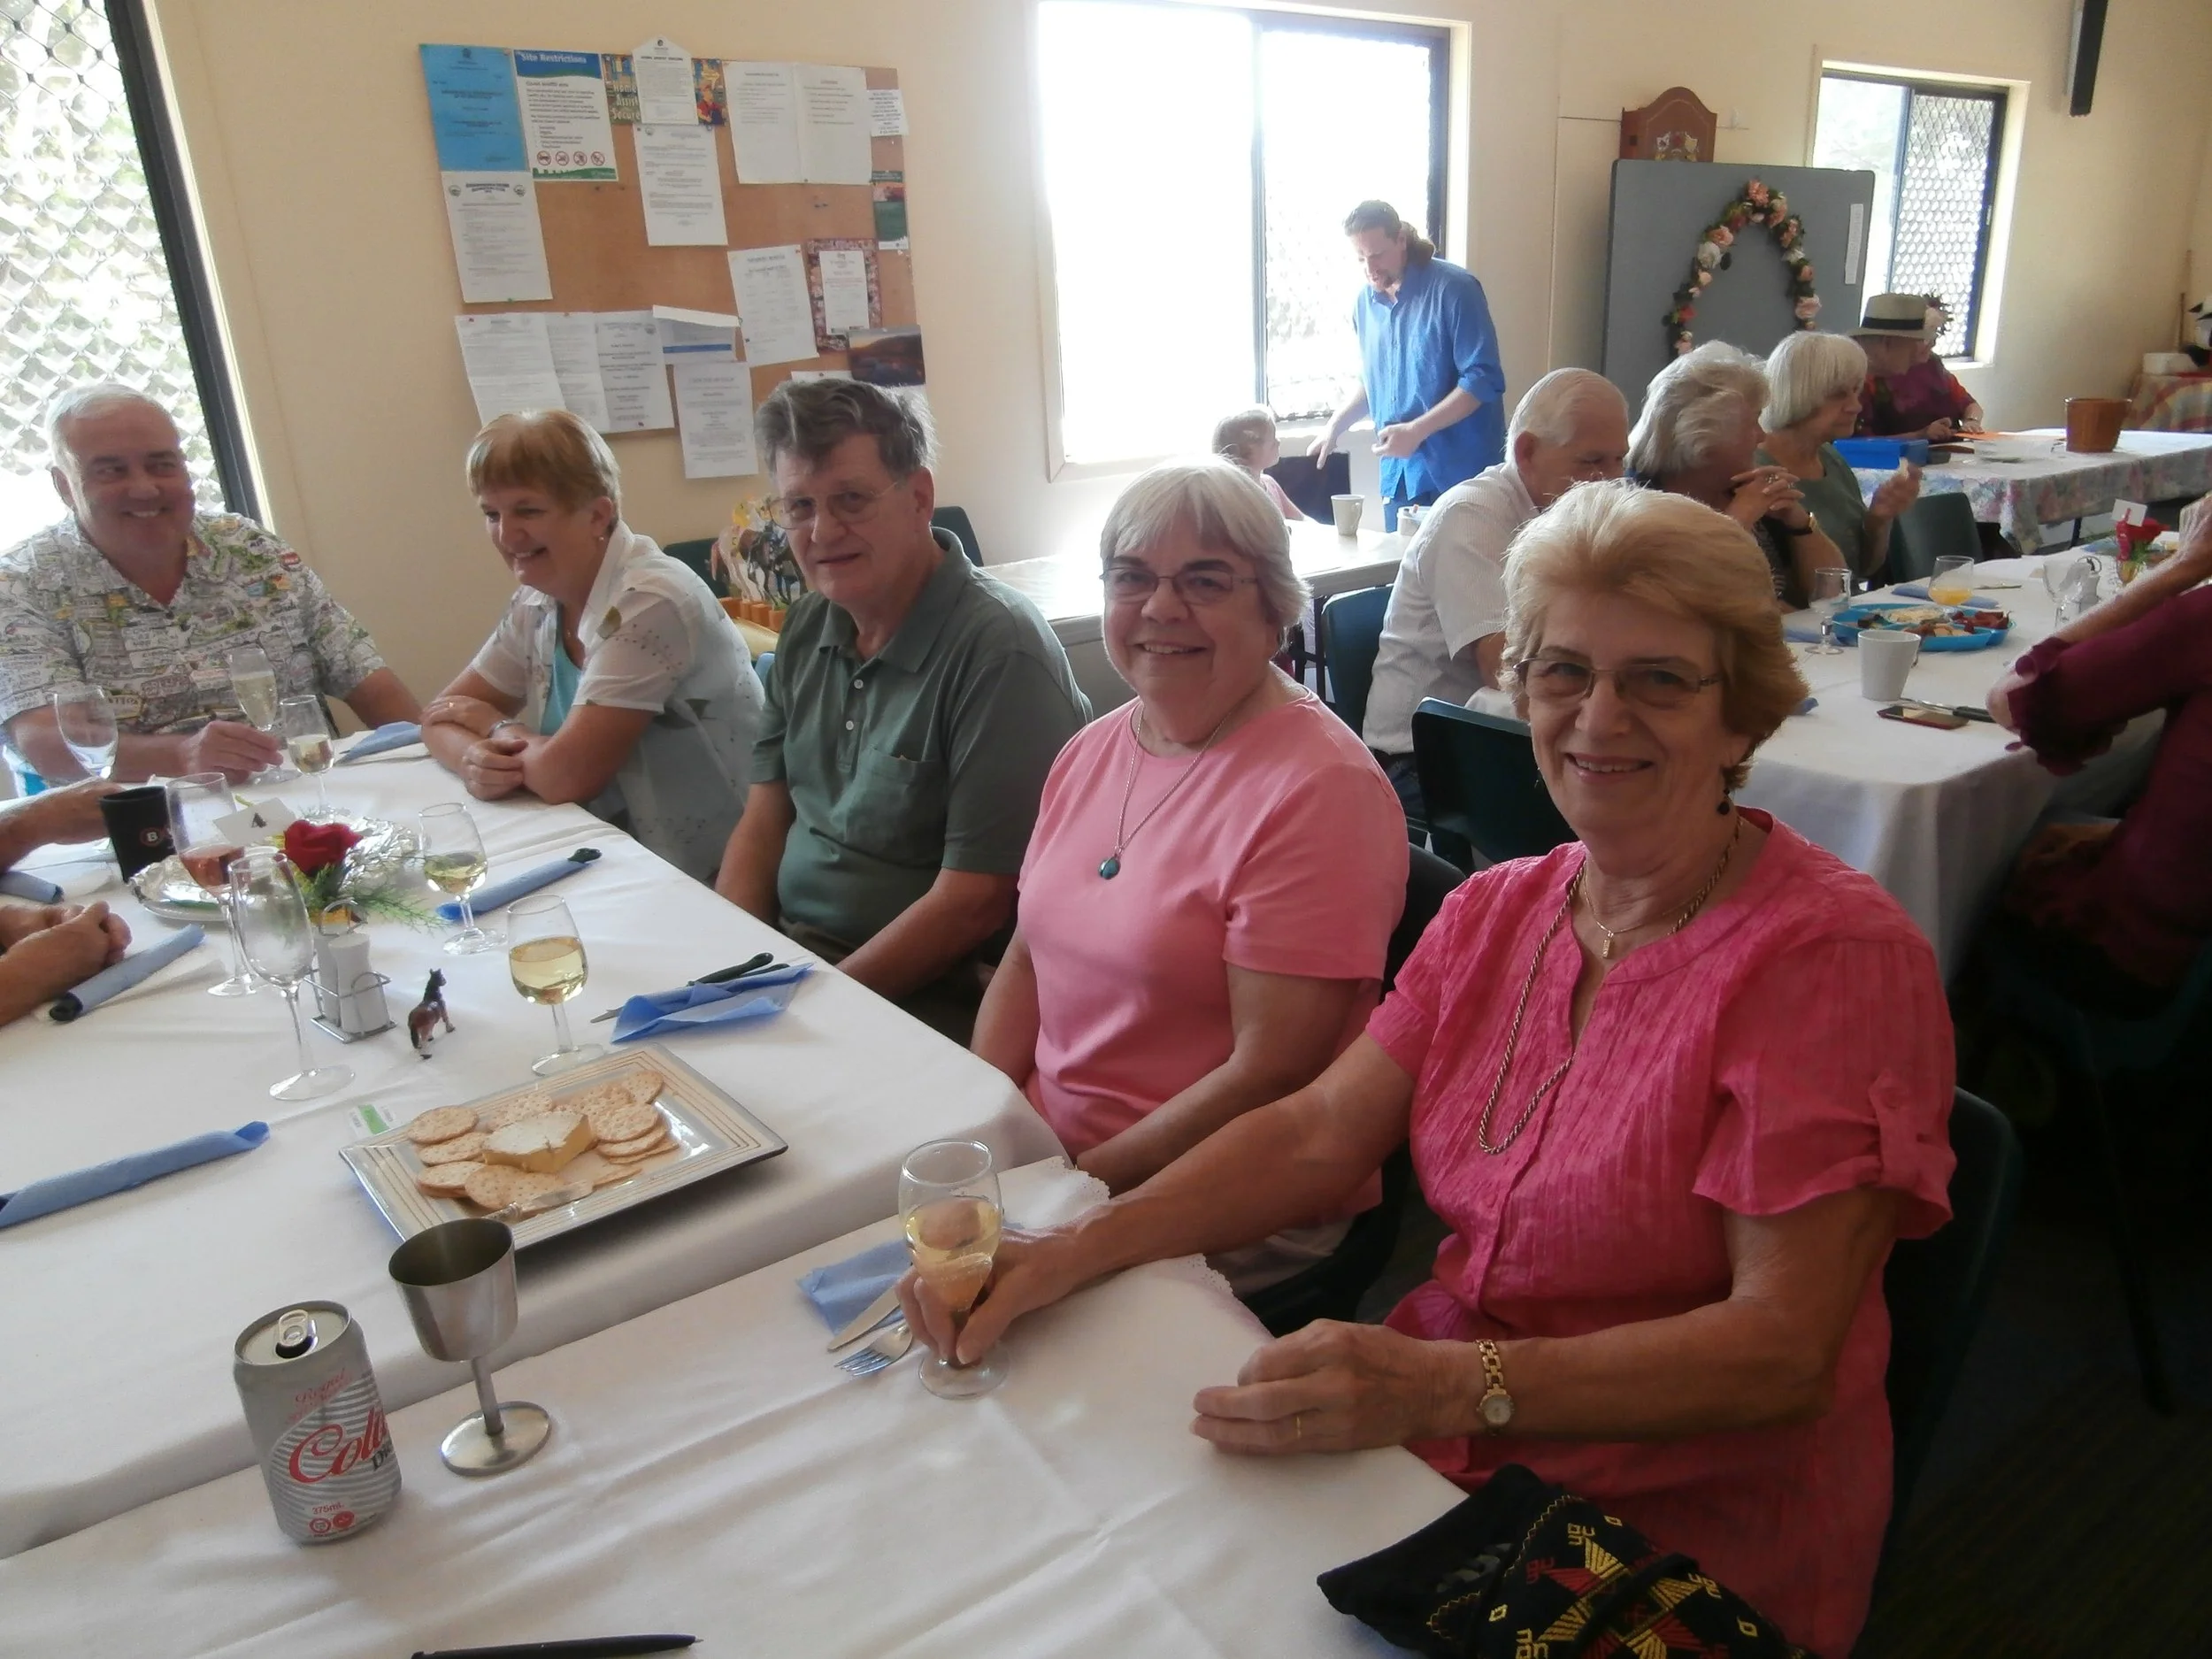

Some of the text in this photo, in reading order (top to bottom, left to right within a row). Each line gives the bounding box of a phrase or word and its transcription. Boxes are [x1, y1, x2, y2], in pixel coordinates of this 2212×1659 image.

[521, 53, 588, 65] Site Restrictions
[613, 84, 637, 93] Home
[611, 107, 641, 120] Secure
